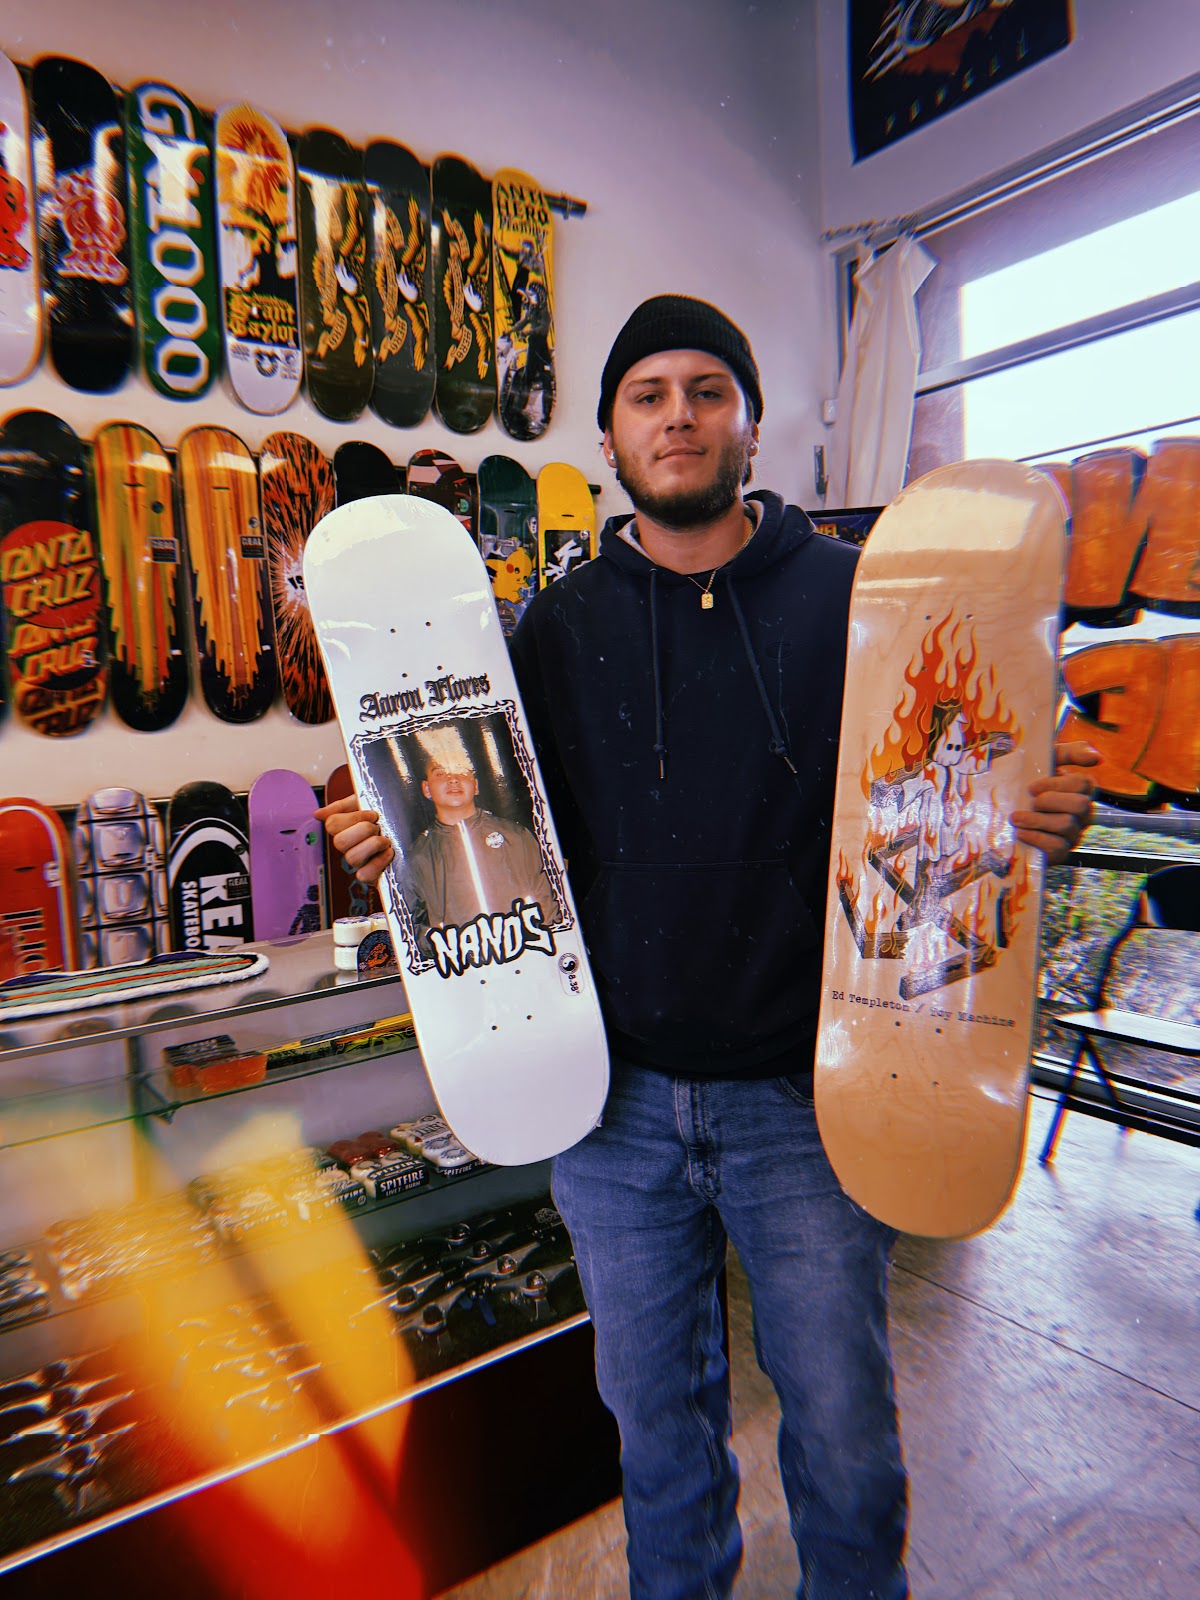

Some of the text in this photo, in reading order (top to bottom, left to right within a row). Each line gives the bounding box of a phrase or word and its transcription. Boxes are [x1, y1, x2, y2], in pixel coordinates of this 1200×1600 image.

[11, 565, 96, 617] CRUZ
[359, 672, 491, 722] Aaron Flores
[227, 877, 249, 887] REAL
[181, 881, 200, 952] SKATEBO
[200, 872, 244, 952] REA
[832, 990, 845, 1001] Ed
[849, 993, 911, 1012] Templeton
[957, 1010, 1017, 1028] Machine
[380, 1169, 425, 1192] SPITFIRE
[443, 1164, 472, 1176] SPITFIRE
